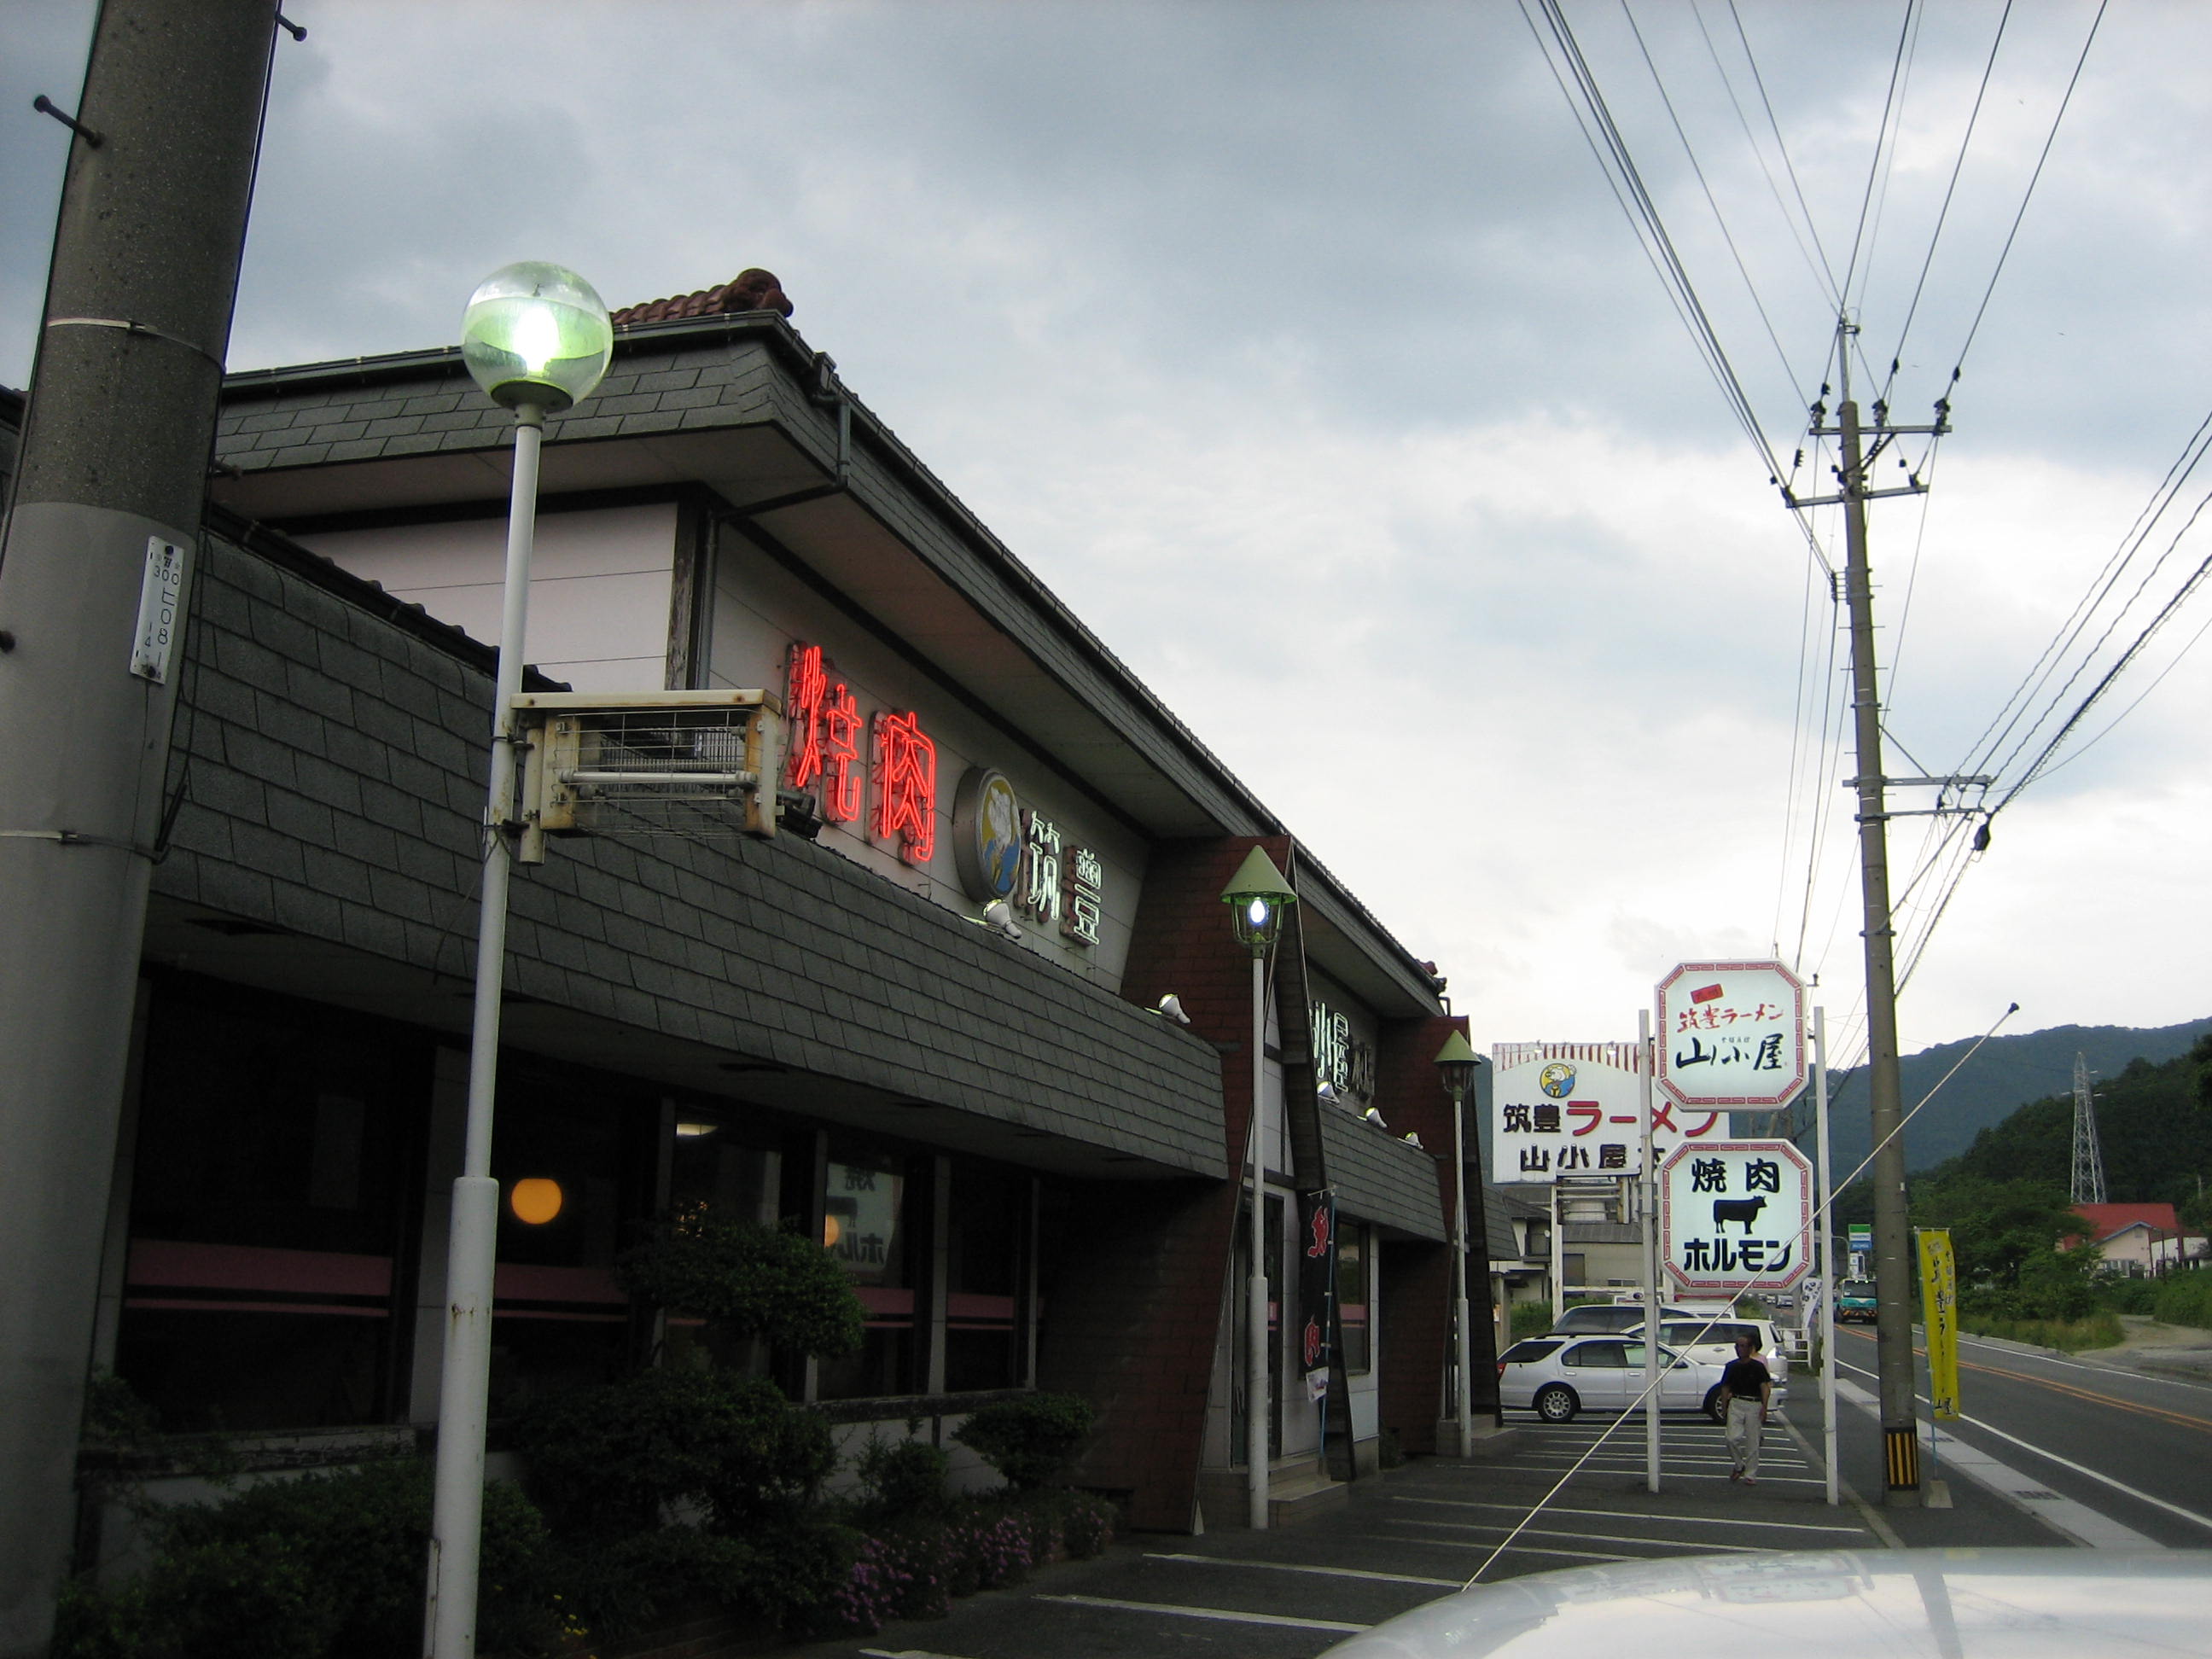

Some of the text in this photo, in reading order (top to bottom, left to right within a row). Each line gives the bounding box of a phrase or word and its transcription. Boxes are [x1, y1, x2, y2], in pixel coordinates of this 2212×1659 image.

[153, 565, 180, 585] 300
[1676, 1003, 1785, 1033] 筑豊ラーメン
[1675, 1033, 1784, 1071] 山小屋
[1691, 1157, 1781, 1195] 焼肉
[1684, 1237, 1791, 1273] ホルモン
